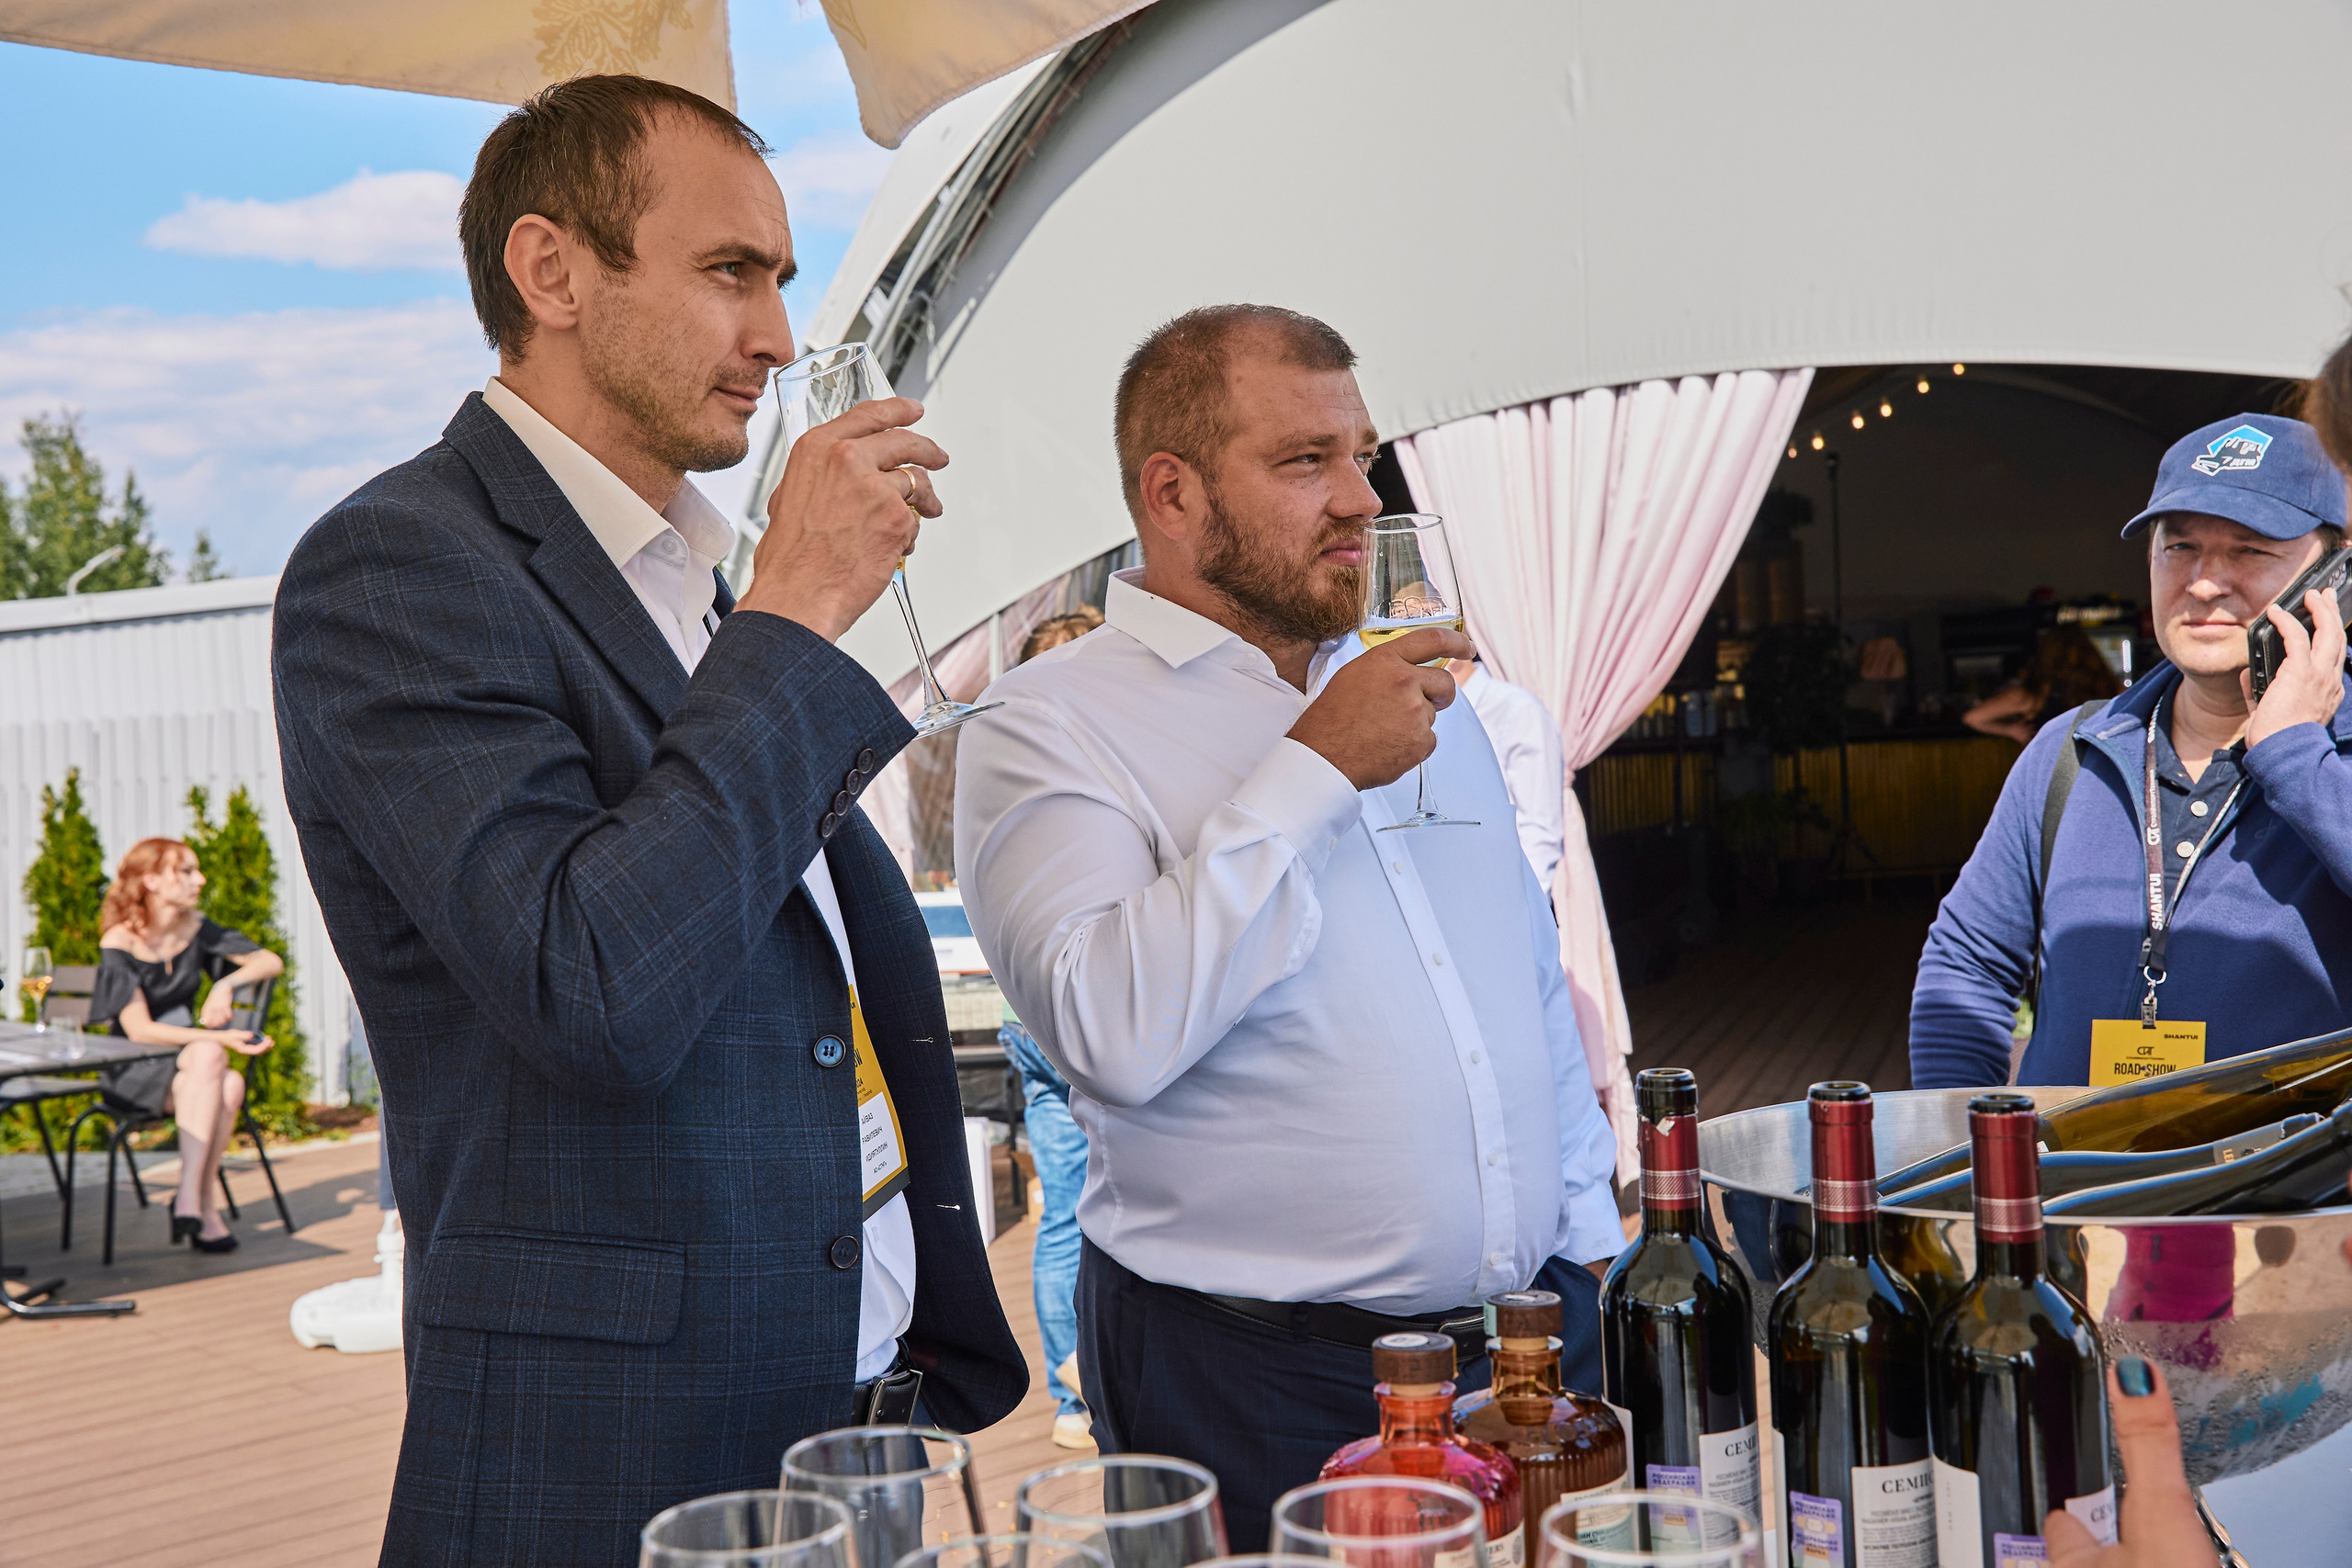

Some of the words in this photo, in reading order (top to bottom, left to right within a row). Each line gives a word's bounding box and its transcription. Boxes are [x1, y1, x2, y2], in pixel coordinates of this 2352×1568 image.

[2149, 873, 2164, 931] SHANTUI
[2114, 1063, 2141, 1075] ROAD
[2146, 1064, 2177, 1076] SHOW
